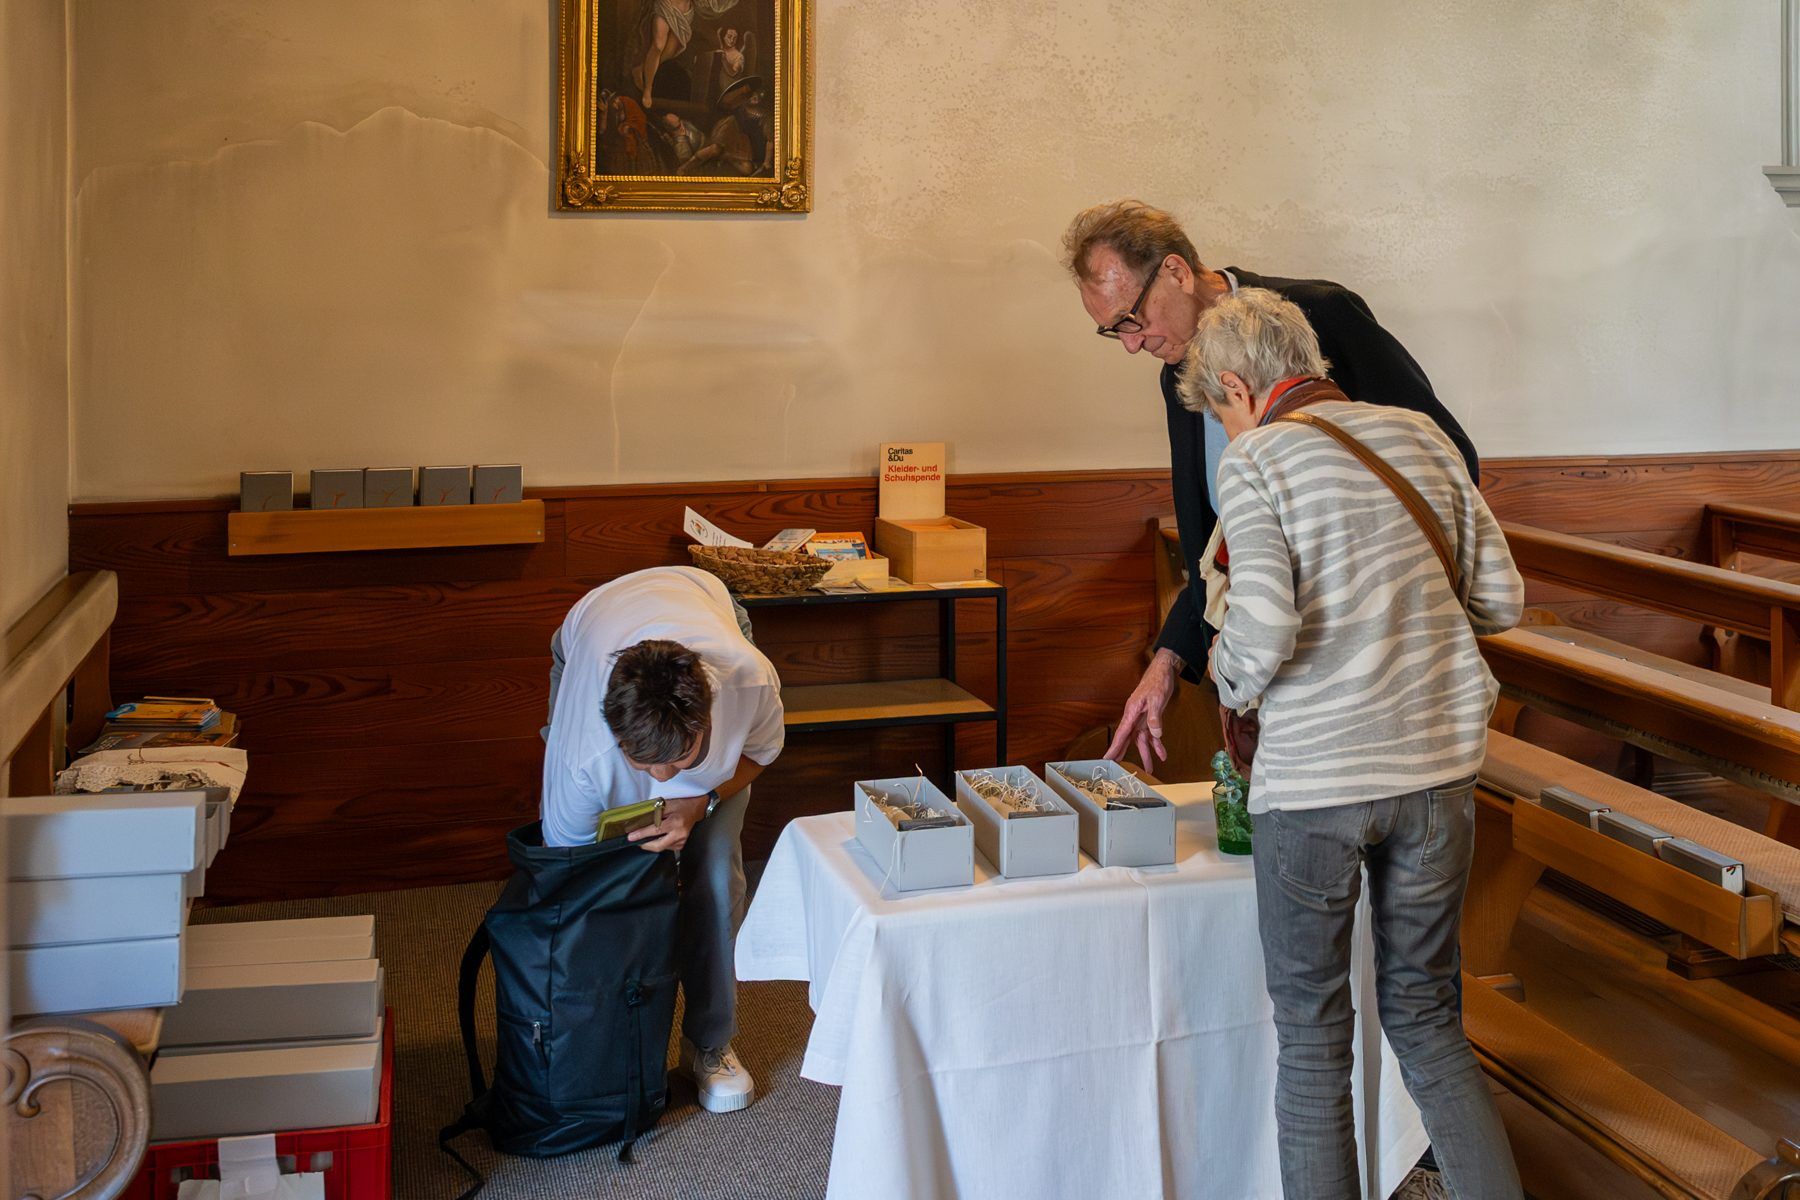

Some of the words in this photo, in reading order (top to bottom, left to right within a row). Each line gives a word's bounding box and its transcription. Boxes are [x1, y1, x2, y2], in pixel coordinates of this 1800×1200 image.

[888, 465, 920, 473] Kleider-
[921, 464, 938, 473] und
[884, 473, 941, 483] Schuhspende
